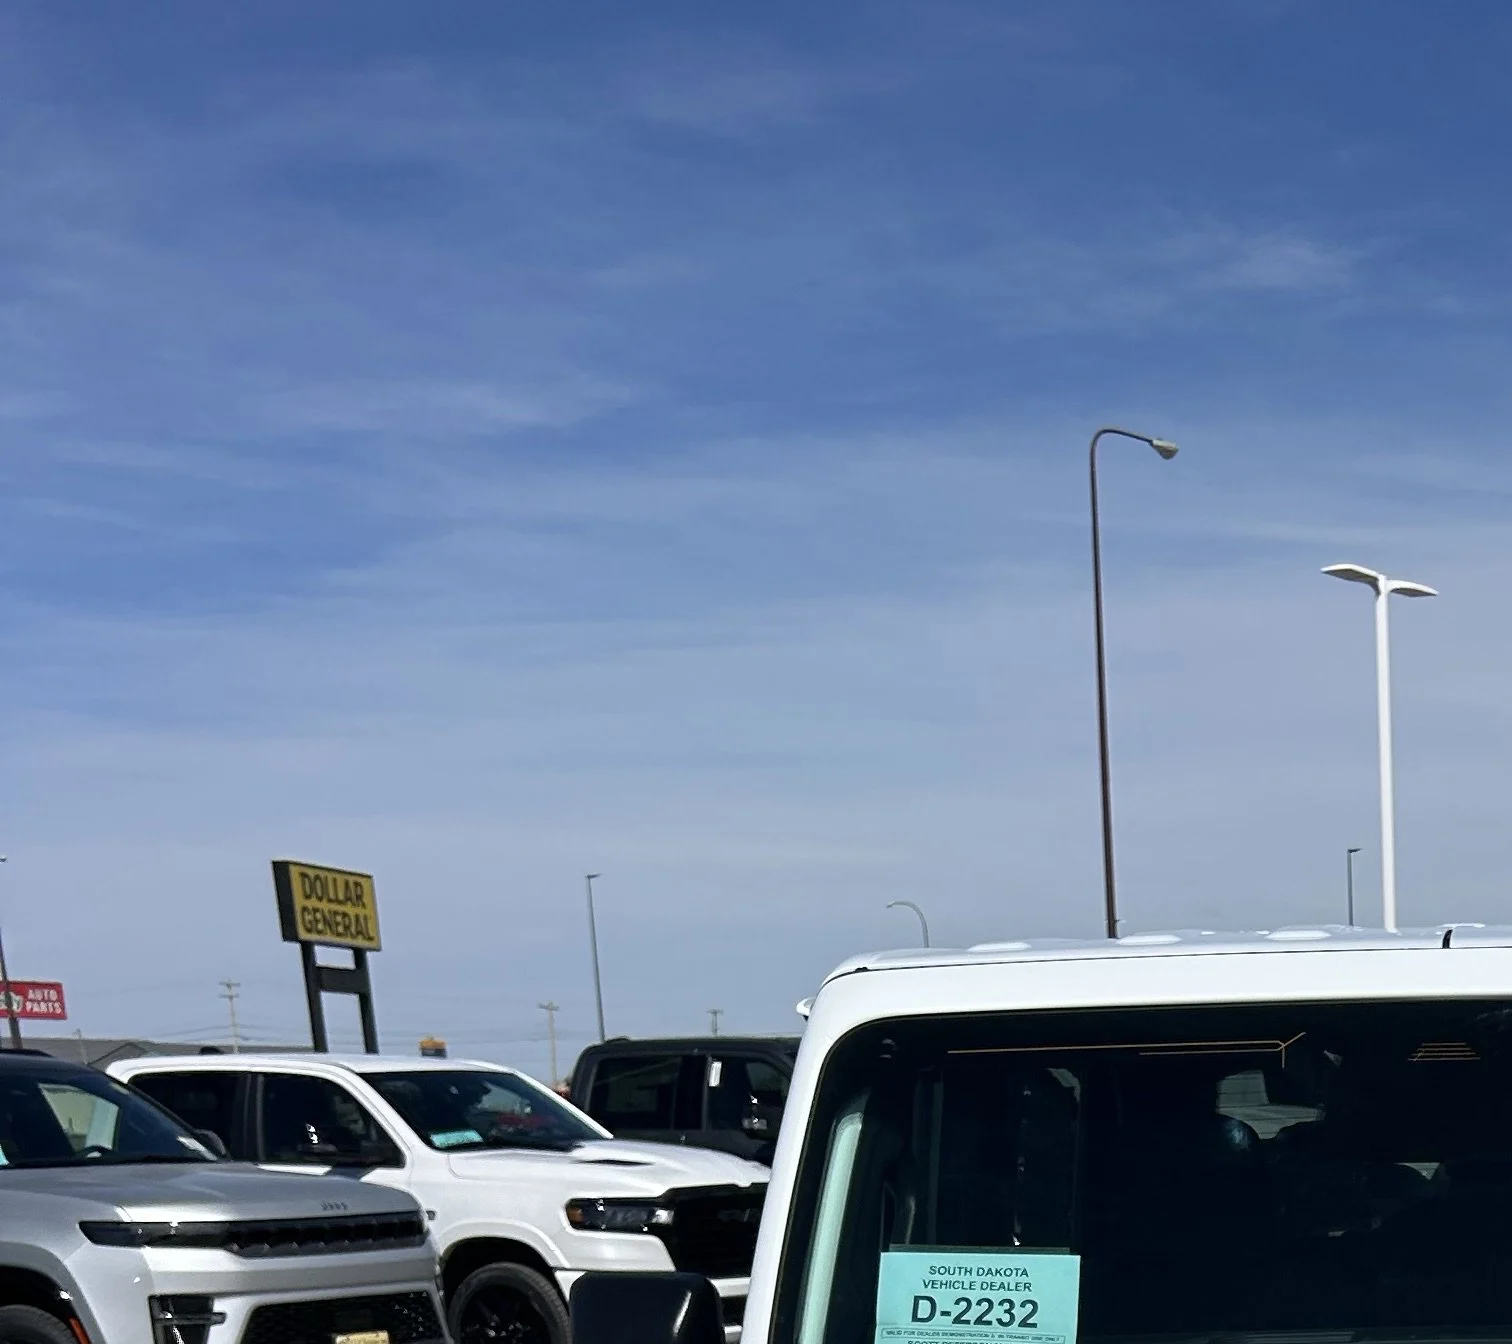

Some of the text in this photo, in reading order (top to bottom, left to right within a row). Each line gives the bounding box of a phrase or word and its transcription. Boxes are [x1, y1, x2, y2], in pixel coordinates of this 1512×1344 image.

[299, 871, 367, 909] DOLLAR
[301, 905, 375, 941] GENERAL
[28, 989, 58, 1001] AUTO
[26, 1001, 62, 1014] PARTS
[929, 1265, 1029, 1278] SOUTH DAKOTA
[922, 1279, 1032, 1292] VEHICLE DEALER
[911, 1295, 1039, 1329] D-2232
